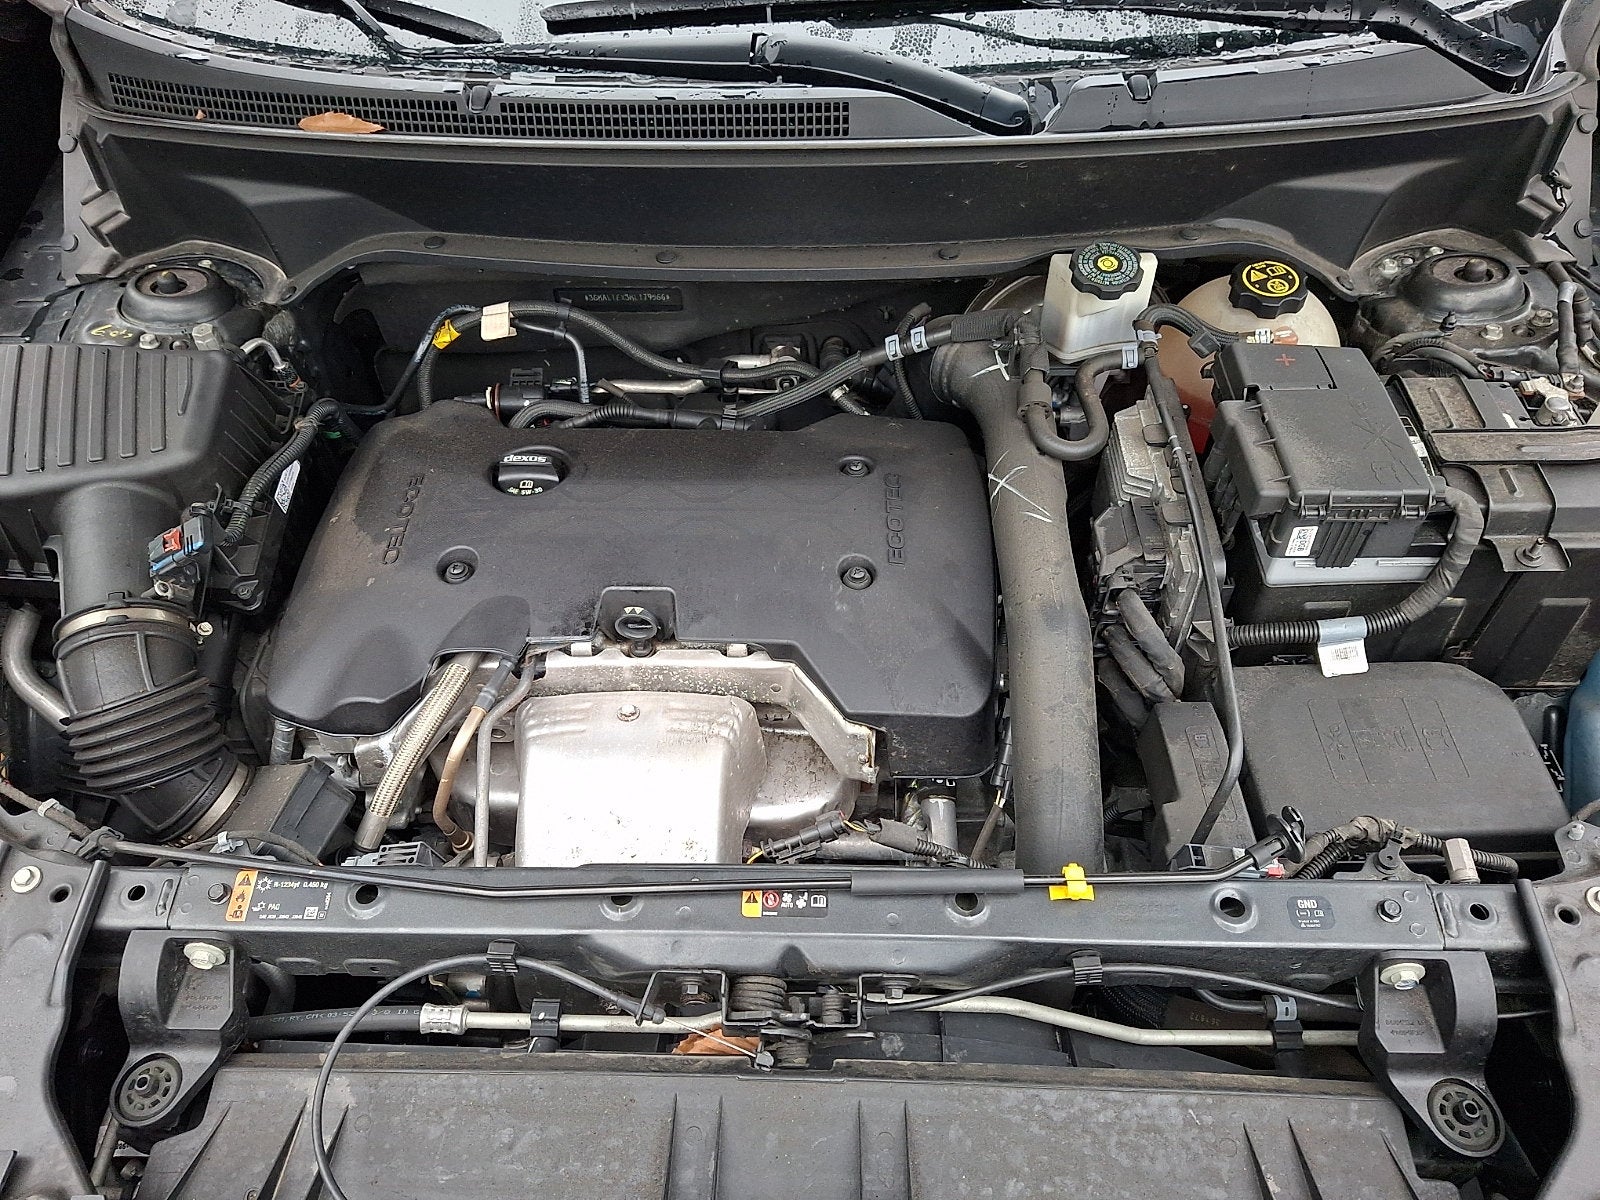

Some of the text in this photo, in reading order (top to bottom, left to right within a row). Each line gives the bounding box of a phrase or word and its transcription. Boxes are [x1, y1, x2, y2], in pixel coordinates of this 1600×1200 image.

[503, 455, 547, 463] dexos
[507, 486, 543, 495] SAE 5W-30
[382, 473, 425, 565] ECOTEC
[884, 472, 906, 567] ECOTEC
[320, 881, 329, 890] kg
[1297, 899, 1318, 909] GND
